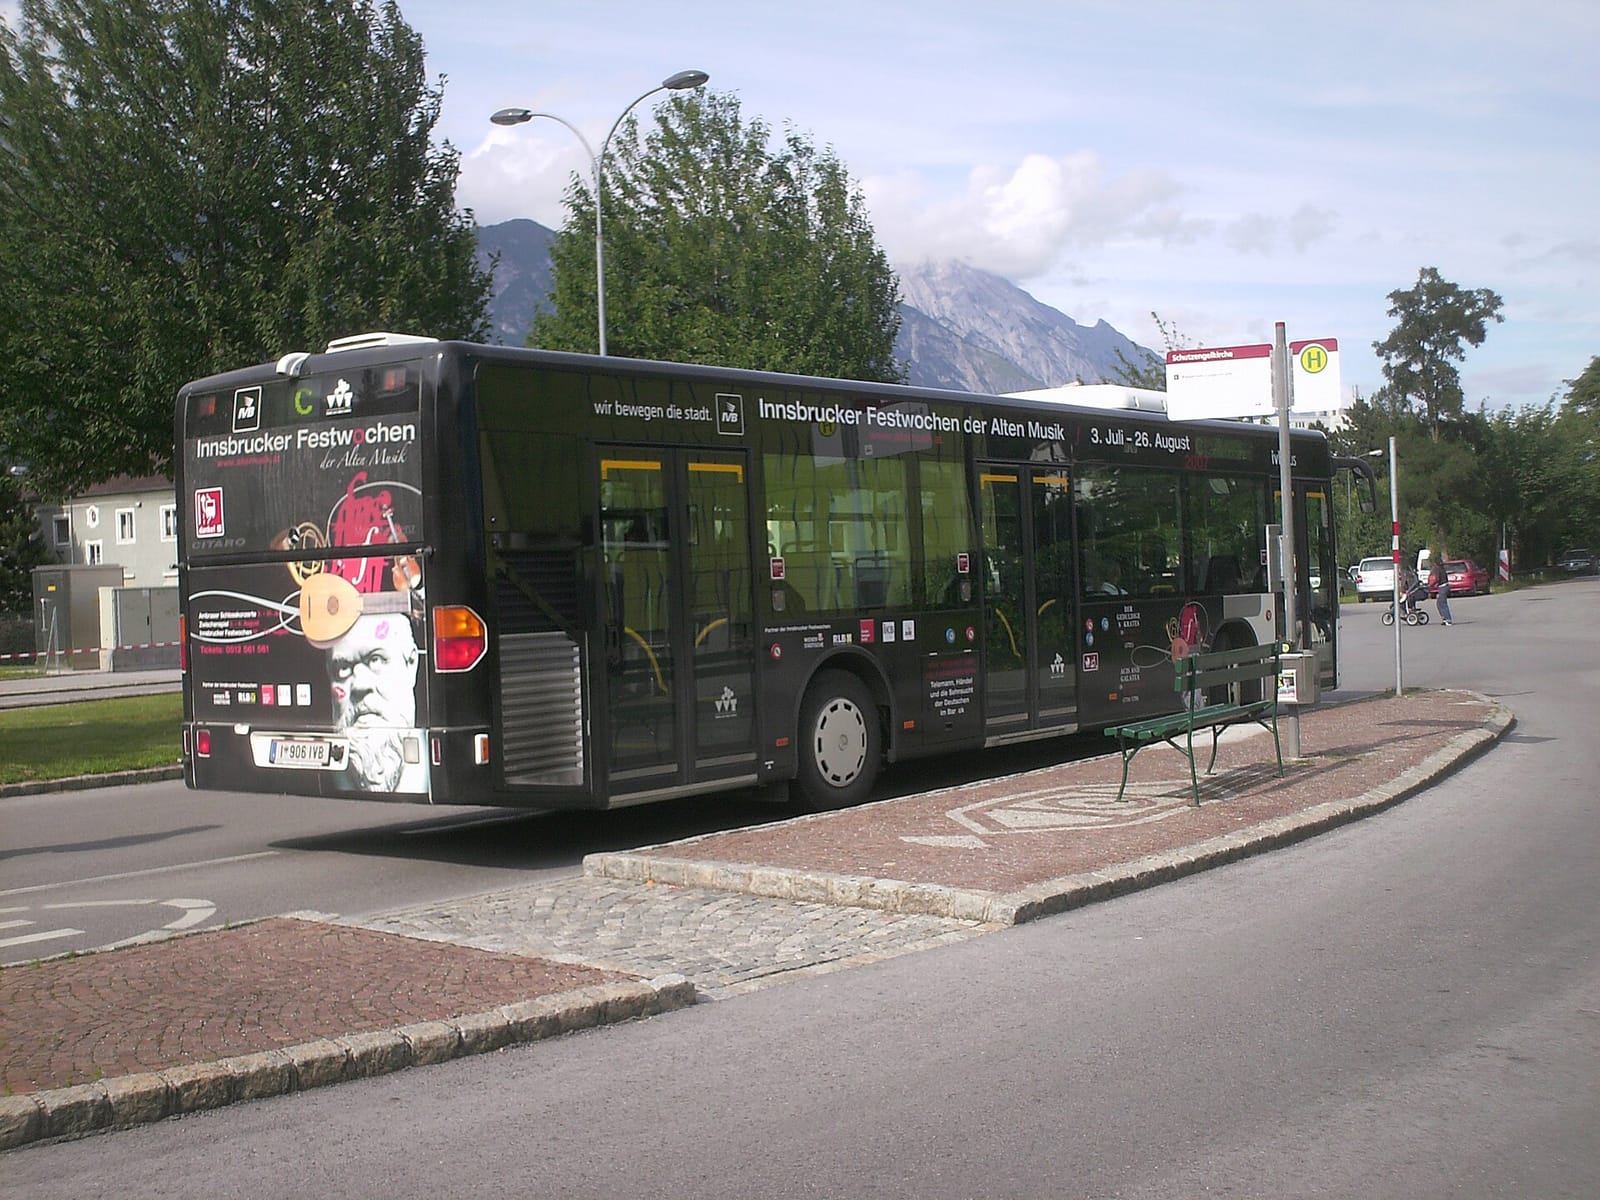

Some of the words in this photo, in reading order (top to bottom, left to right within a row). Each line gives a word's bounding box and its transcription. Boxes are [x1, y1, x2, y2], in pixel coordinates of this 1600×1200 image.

[1171, 350, 1234, 363] Schutzengelkirche
[1307, 351, 1322, 369] H
[294, 388, 313, 415] C
[594, 400, 612, 415] wir
[614, 400, 663, 421] bewegen
[666, 404, 682, 419] die
[684, 406, 713, 421] stadt.
[721, 412, 738, 422] IVB
[758, 398, 864, 425] Innsbrucker
[866, 406, 960, 432] Festwochen
[963, 416, 987, 434] der
[990, 418, 1025, 438] Alten
[1028, 421, 1066, 441] Musik
[196, 432, 292, 458] Innsbrucker
[297, 422, 416, 449] Festwochen
[1090, 428, 1102, 444] 3.
[1105, 429, 1124, 446] Juli
[1134, 431, 1152, 448] 26.
[1155, 433, 1191, 454] August
[320, 445, 336, 471] der
[336, 444, 366, 469] Alten
[368, 441, 413, 467] Musik
[1184, 456, 1209, 470] 2007
[192, 537, 246, 550] CITARO
[930, 690, 939, 698] und
[290, 744, 306, 759] 906
[308, 745, 324, 760] IVB
